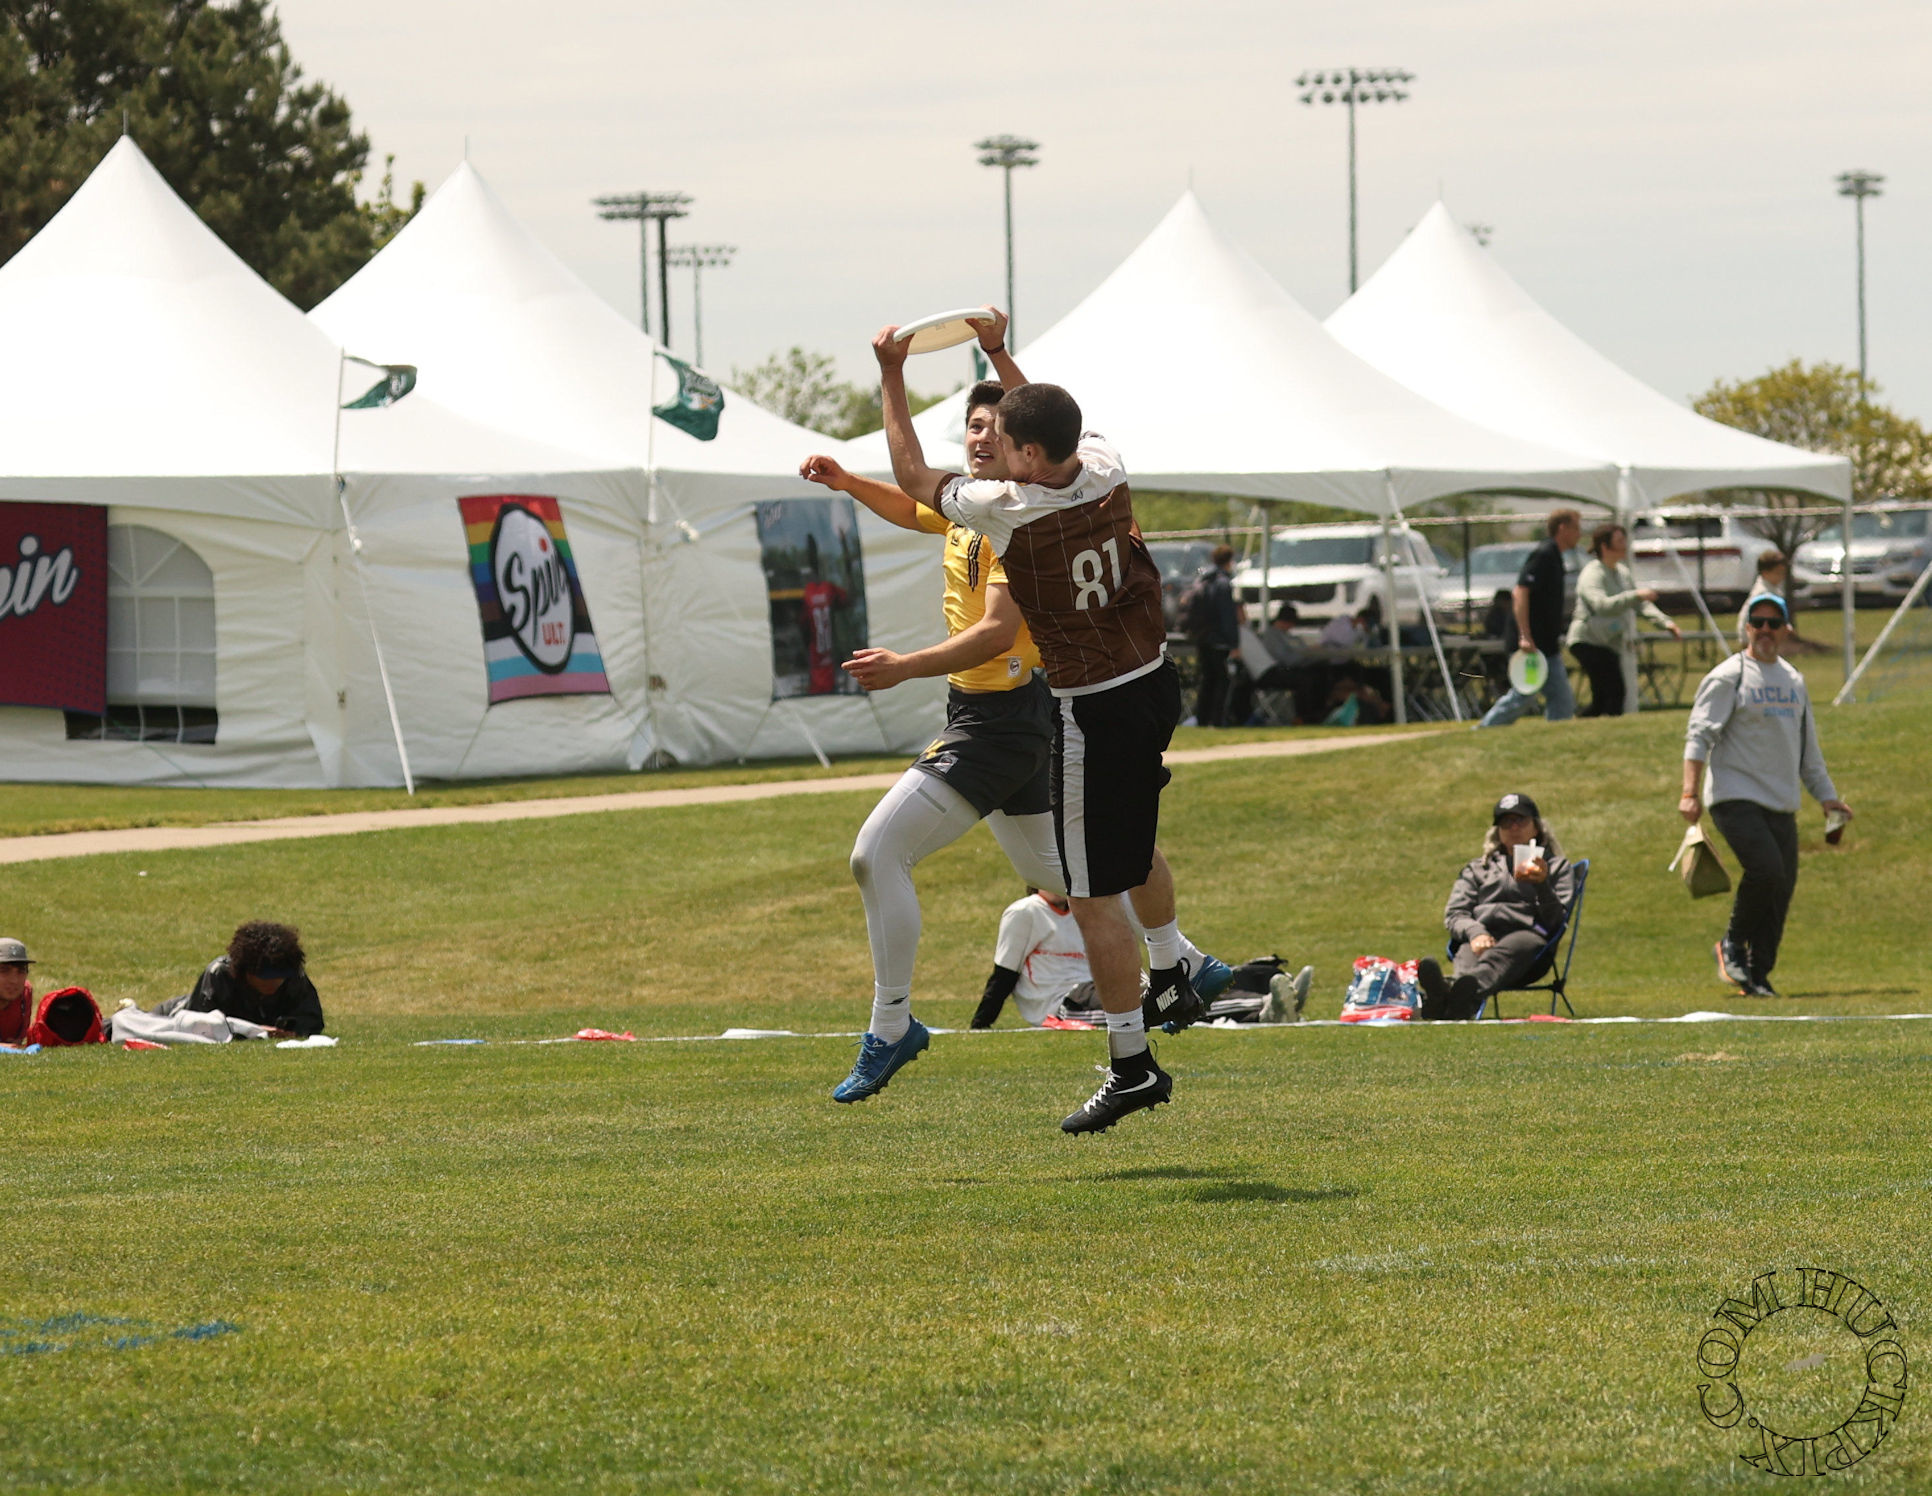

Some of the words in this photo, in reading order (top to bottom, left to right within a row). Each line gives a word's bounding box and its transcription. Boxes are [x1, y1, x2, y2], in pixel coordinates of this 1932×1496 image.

[502, 537, 566, 647] Spin
[1071, 537, 1122, 611] 81
[1750, 687, 1800, 705] UCLA
[1155, 984, 1179, 1012] NIKE
